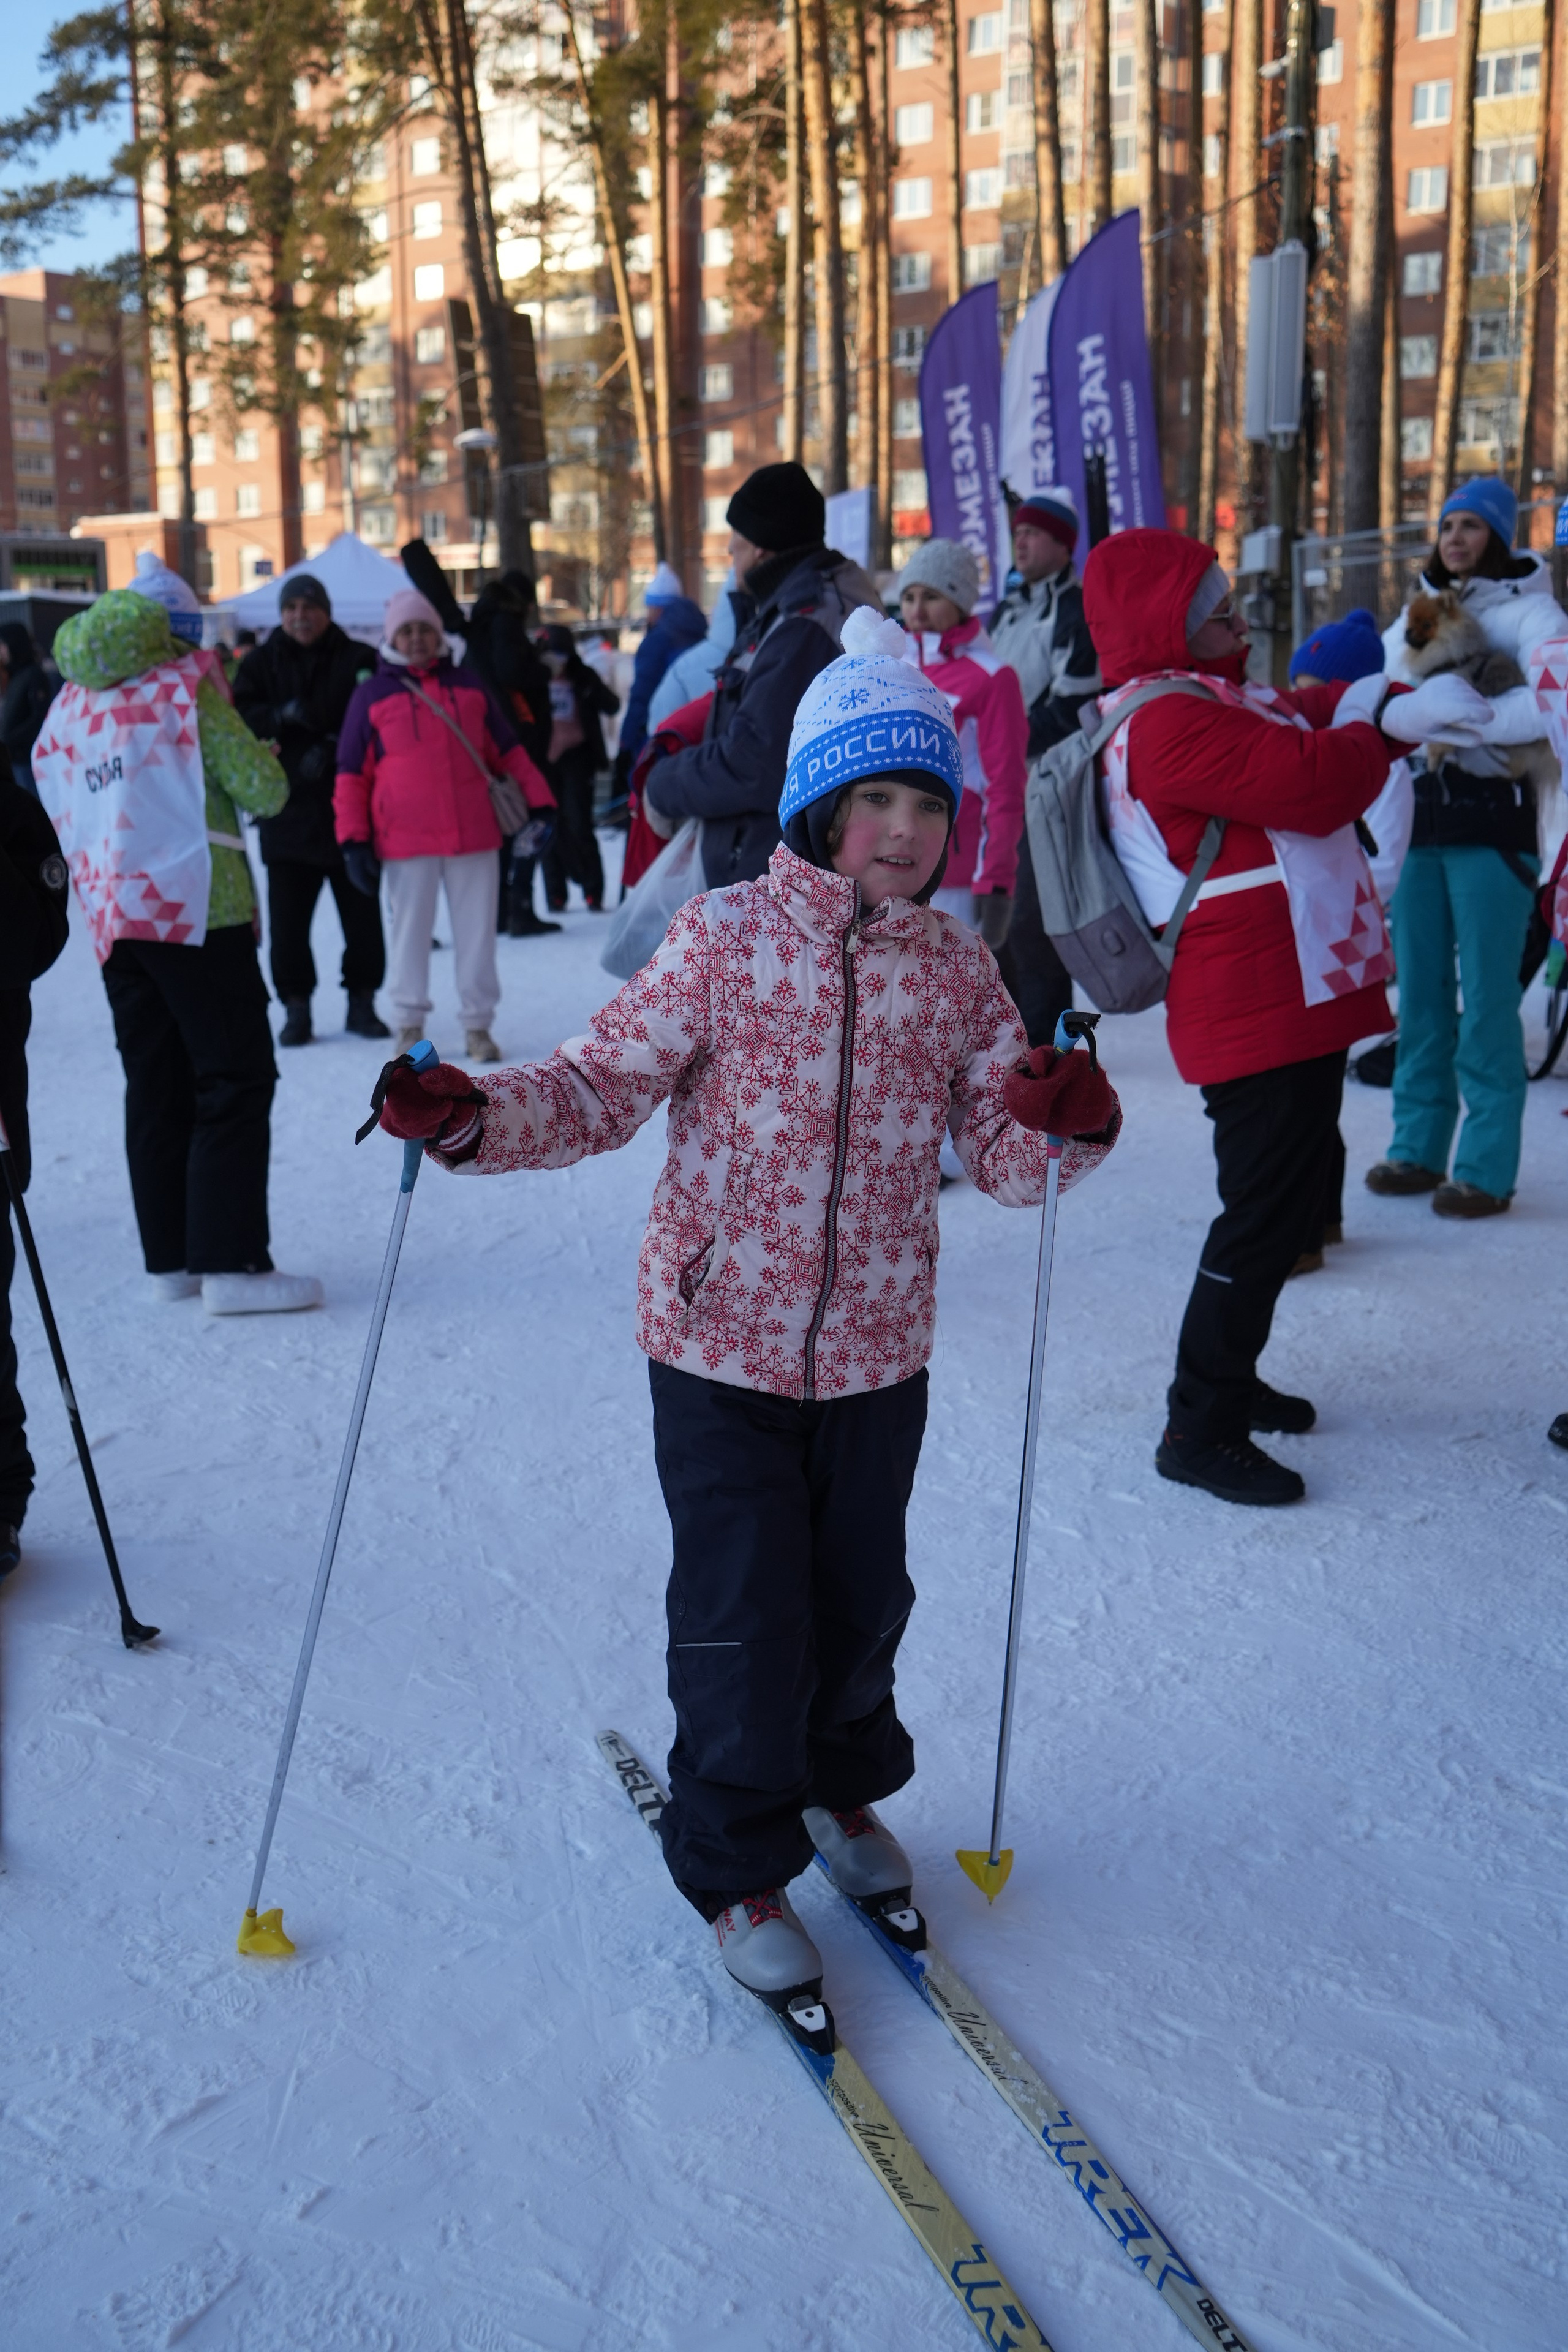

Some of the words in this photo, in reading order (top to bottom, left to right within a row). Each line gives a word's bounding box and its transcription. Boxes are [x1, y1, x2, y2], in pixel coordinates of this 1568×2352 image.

[807, 726, 940, 782] РОССИИ
[922, 1975, 952, 2009] sportpositive
[947, 2011, 1029, 2084] Universal
[829, 2078, 859, 2119] sportpositive
[853, 2123, 939, 2212] Universal
